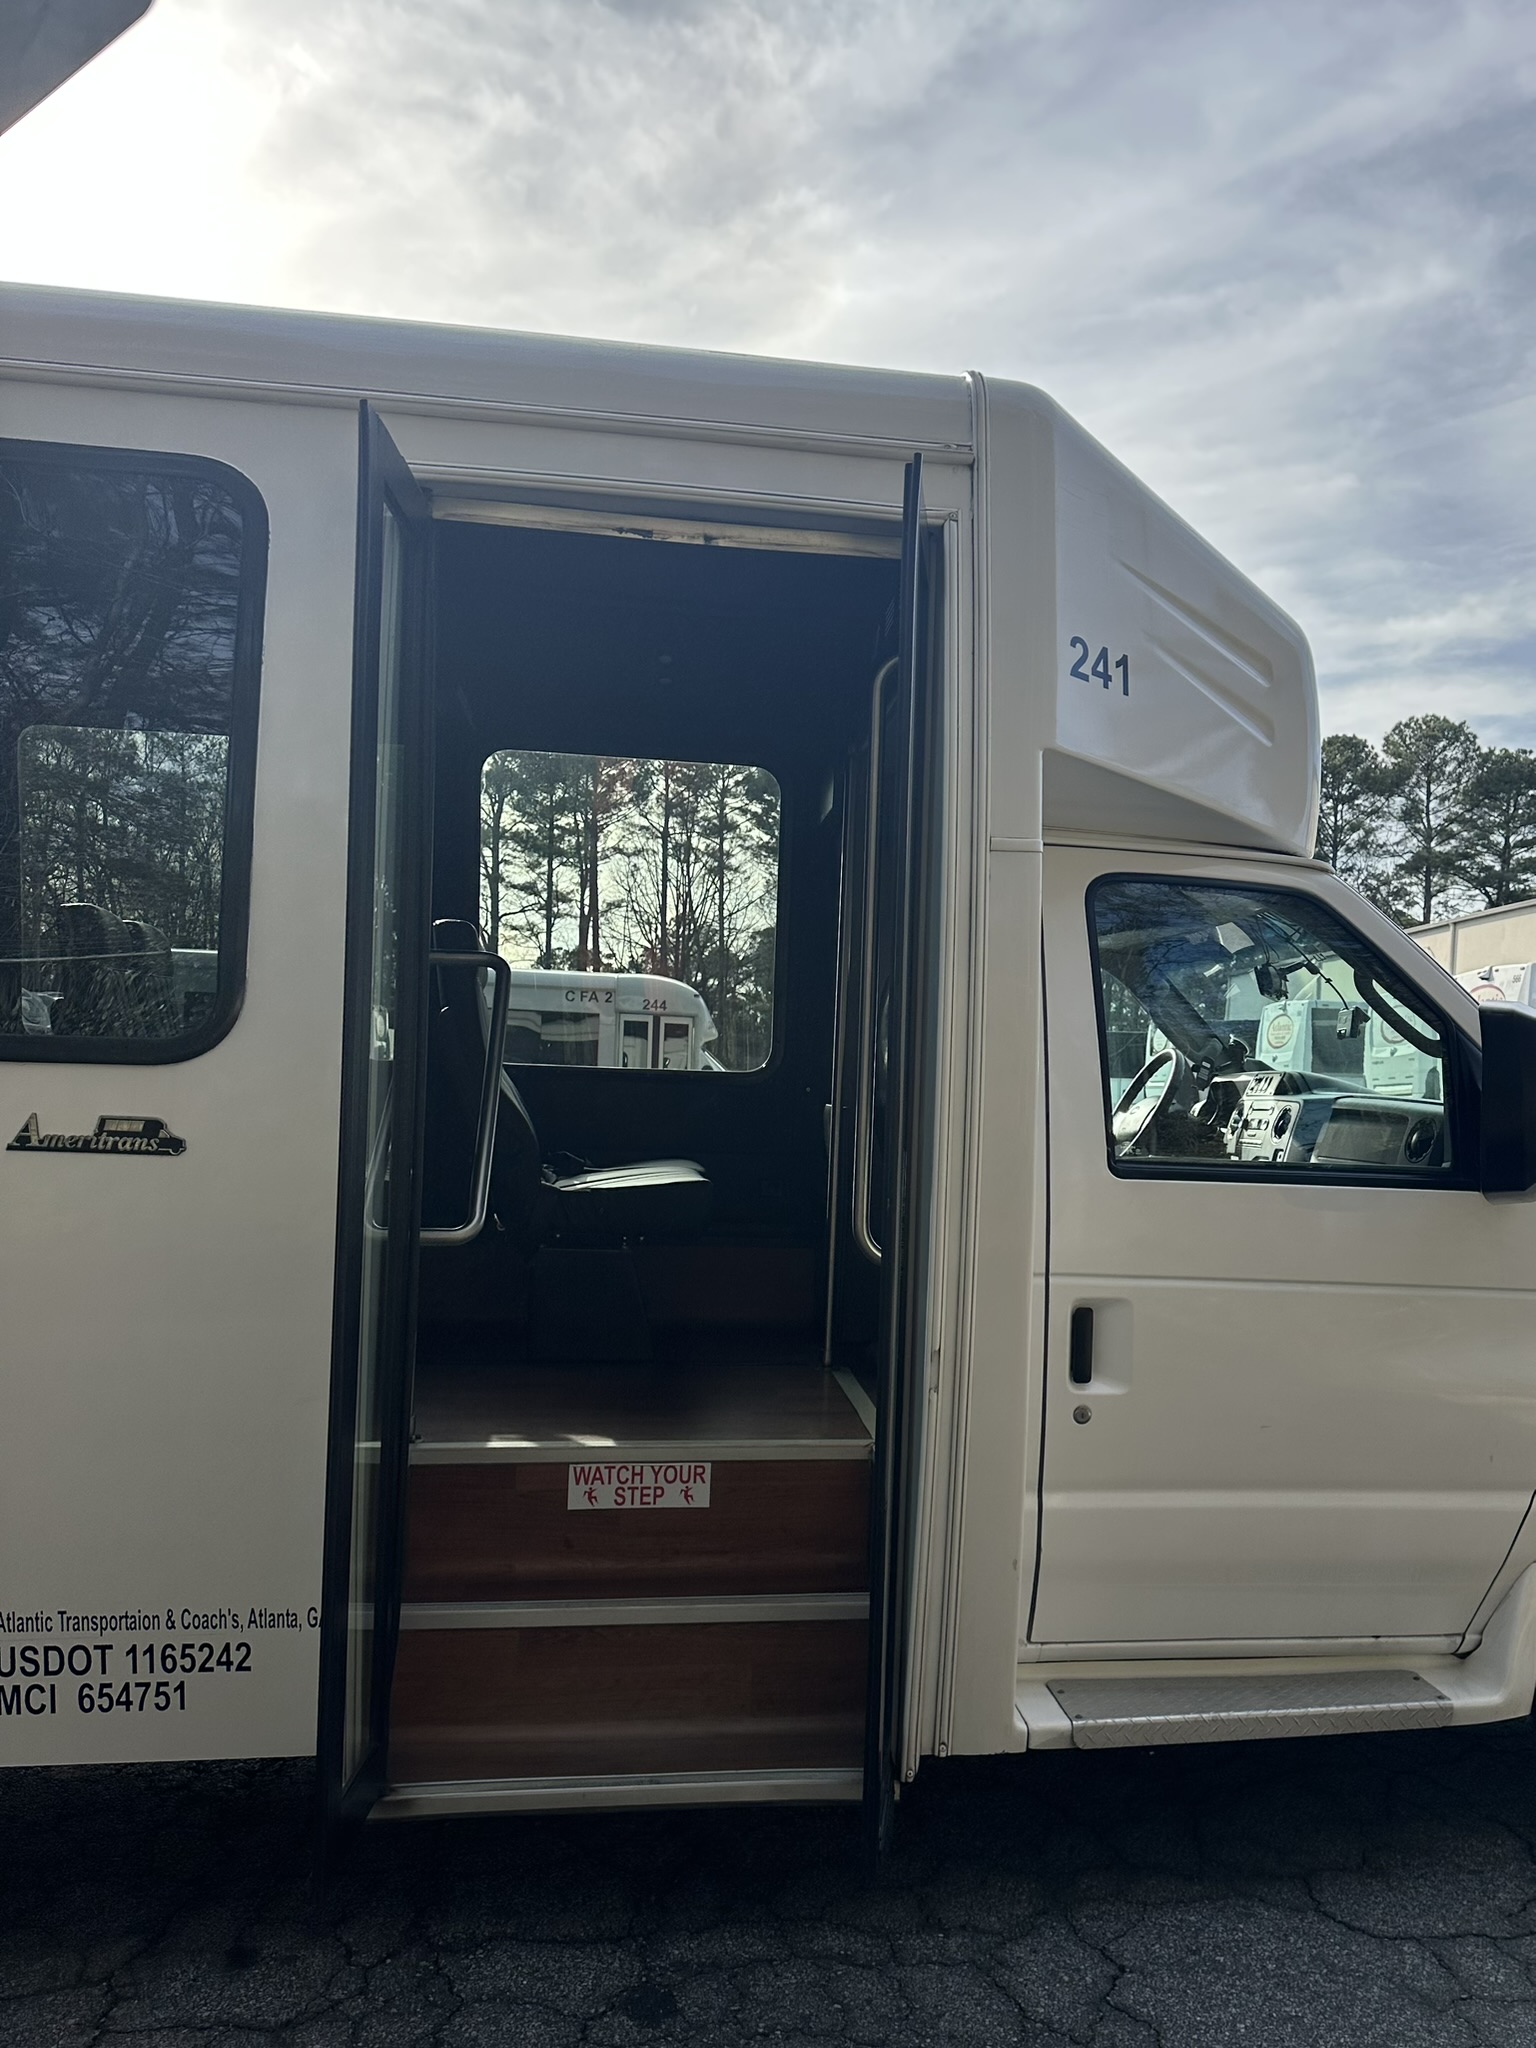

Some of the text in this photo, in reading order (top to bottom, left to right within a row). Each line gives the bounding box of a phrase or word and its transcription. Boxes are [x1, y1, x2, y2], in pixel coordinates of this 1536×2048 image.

[1069, 635, 1130, 697] 241
[642, 999, 667, 1012] 244
[8, 1112, 160, 1152] Ameritrans
[573, 1464, 706, 1486] WATCH YOUR
[613, 1486, 665, 1506] STEP
[57, 1609, 160, 1636] Transportaion
[166, 1608, 176, 1630] &
[181, 1607, 244, 1633] Coach's,
[247, 1607, 303, 1632] Atlanta,
[307, 1606, 322, 1628] G
[0, 1642, 252, 1678] USDOT 1165242
[0, 1680, 186, 1715] MCI 654751
